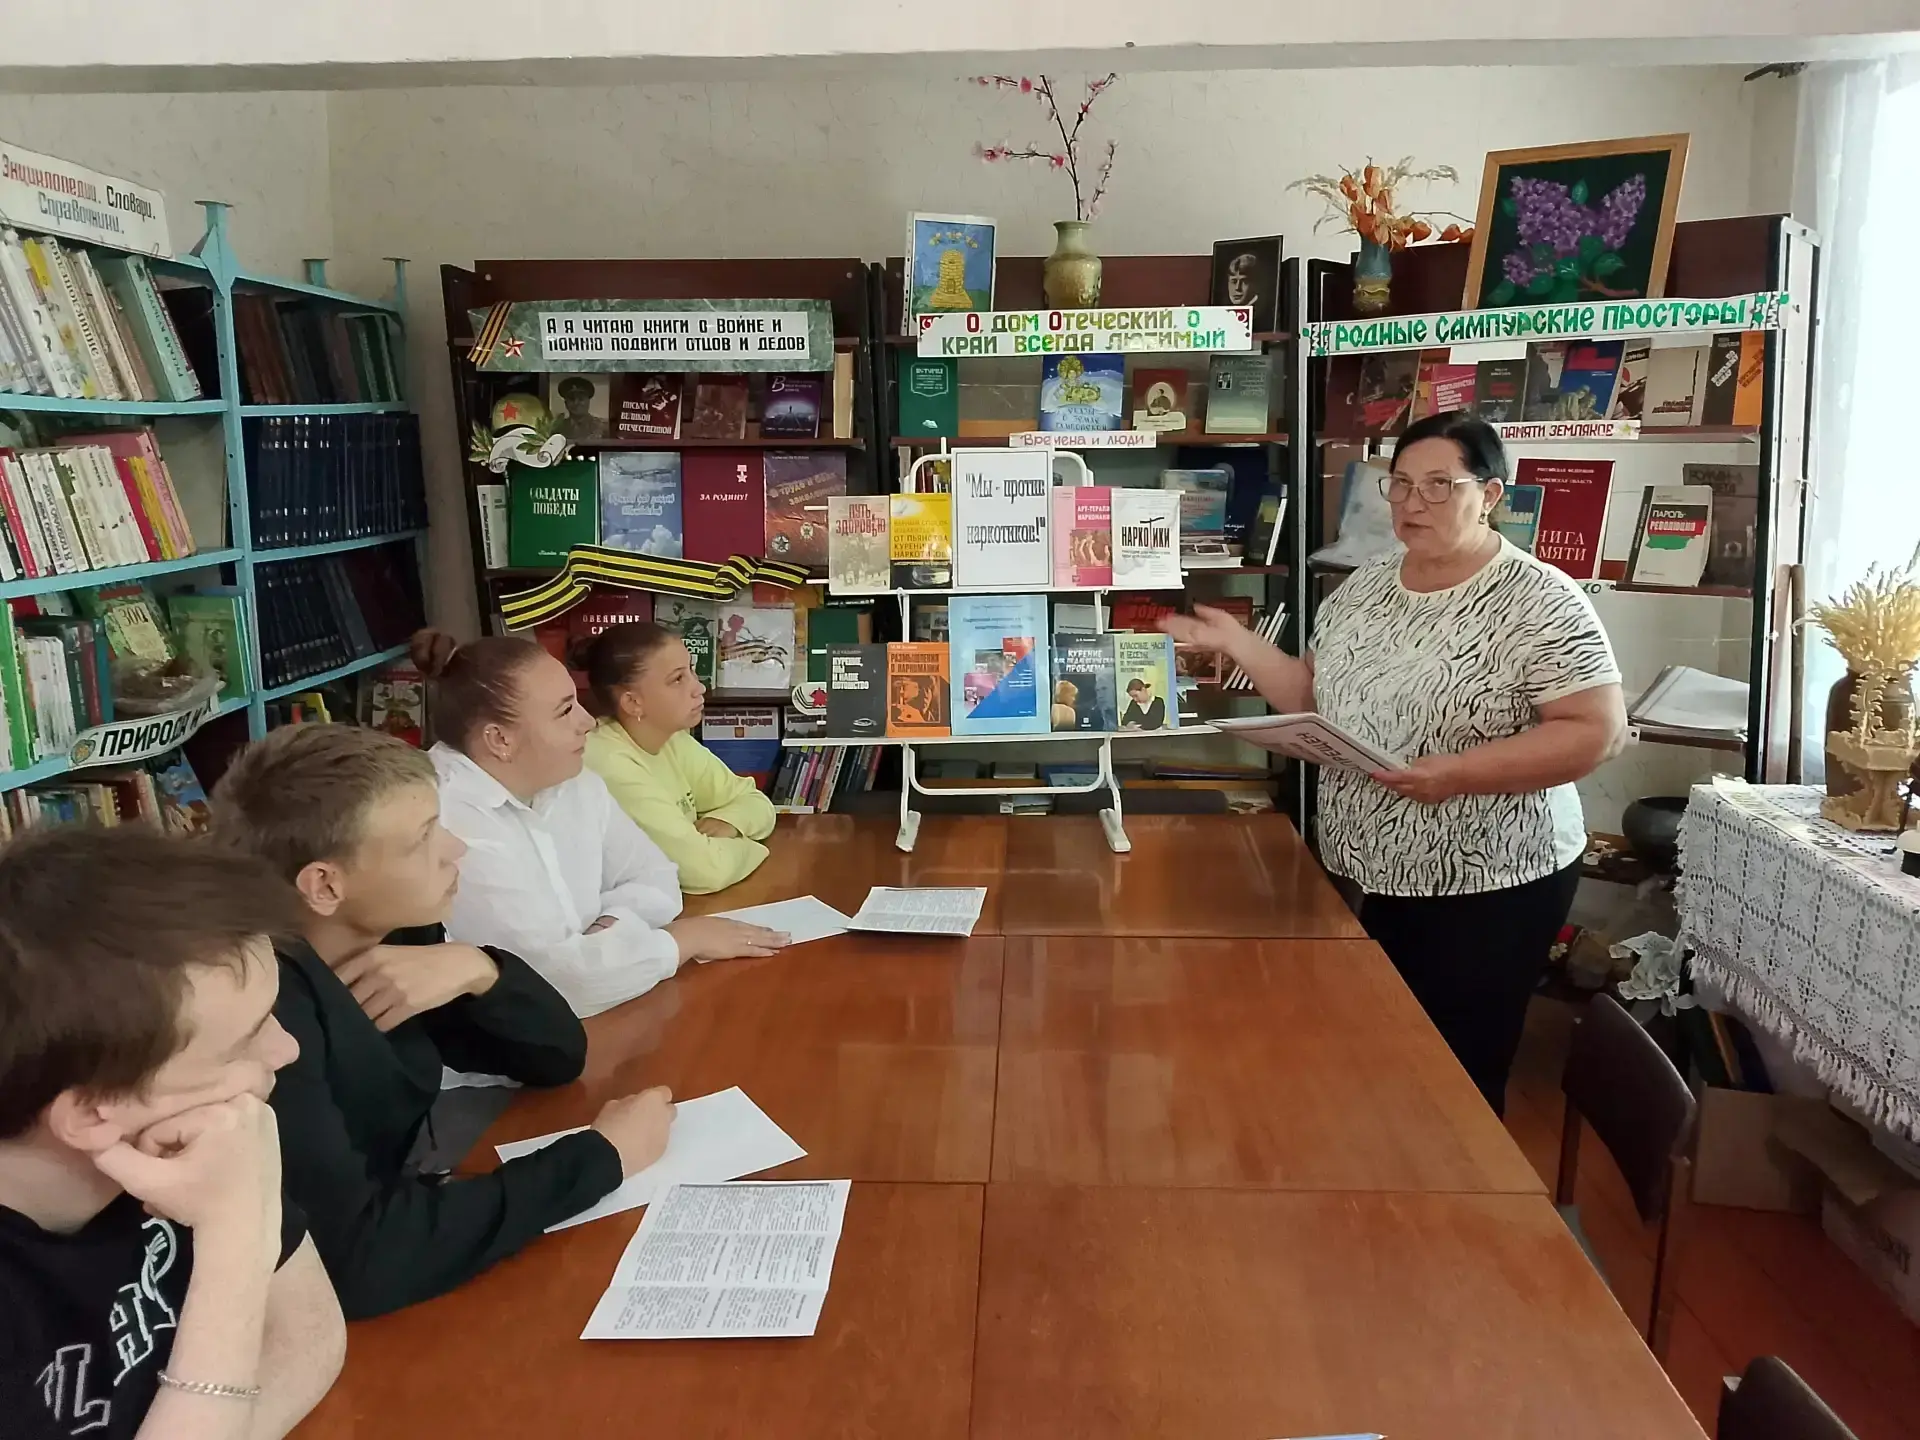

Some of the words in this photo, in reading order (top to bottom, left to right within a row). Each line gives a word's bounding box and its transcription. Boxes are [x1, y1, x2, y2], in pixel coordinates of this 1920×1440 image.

[2, 154, 101, 204] Энциклопедии.
[106, 185, 156, 222] Словари.
[38, 191, 125, 234] Справочники.
[1187, 310, 1200, 328] О
[1602, 299, 1746, 331] ПРОСТОРЫ
[547, 318, 557, 334] А
[564, 320, 574, 334] Я
[583, 319, 633, 334] ЧИТАЮ
[643, 319, 689, 334] КНИГИ
[772, 319, 782, 333] И
[548, 338, 603, 351] ПОМНЮ
[611, 337, 677, 351] ПОДВИГИ
[686, 337, 731, 351] ОТЦОВ
[739, 337, 749, 351] И
[757, 336, 805, 351] ДЕДОВ
[1500, 426, 1545, 439] ПАМЯТИ
[1550, 423, 1614, 436] ЗЕМЛЯКОВ
[530, 488, 579, 501] СОЛДАТЫ
[713, 493, 748, 502] РОДИНУ!
[1003, 479, 1045, 504] против
[533, 502, 576, 517] ПОБЕДЫ
[849, 503, 871, 519] ПУТЬ
[835, 518, 886, 537] ЗДОРОВЬЮ
[1121, 517, 1170, 549] НАРКОТИКИ
[1649, 520, 1696, 532] РЕВОЛЮЦИЯ
[1540, 530, 1585, 545] НИГА
[1539, 545, 1587, 561] МЯТИ
[99, 711, 190, 757] ПРИРОДА
